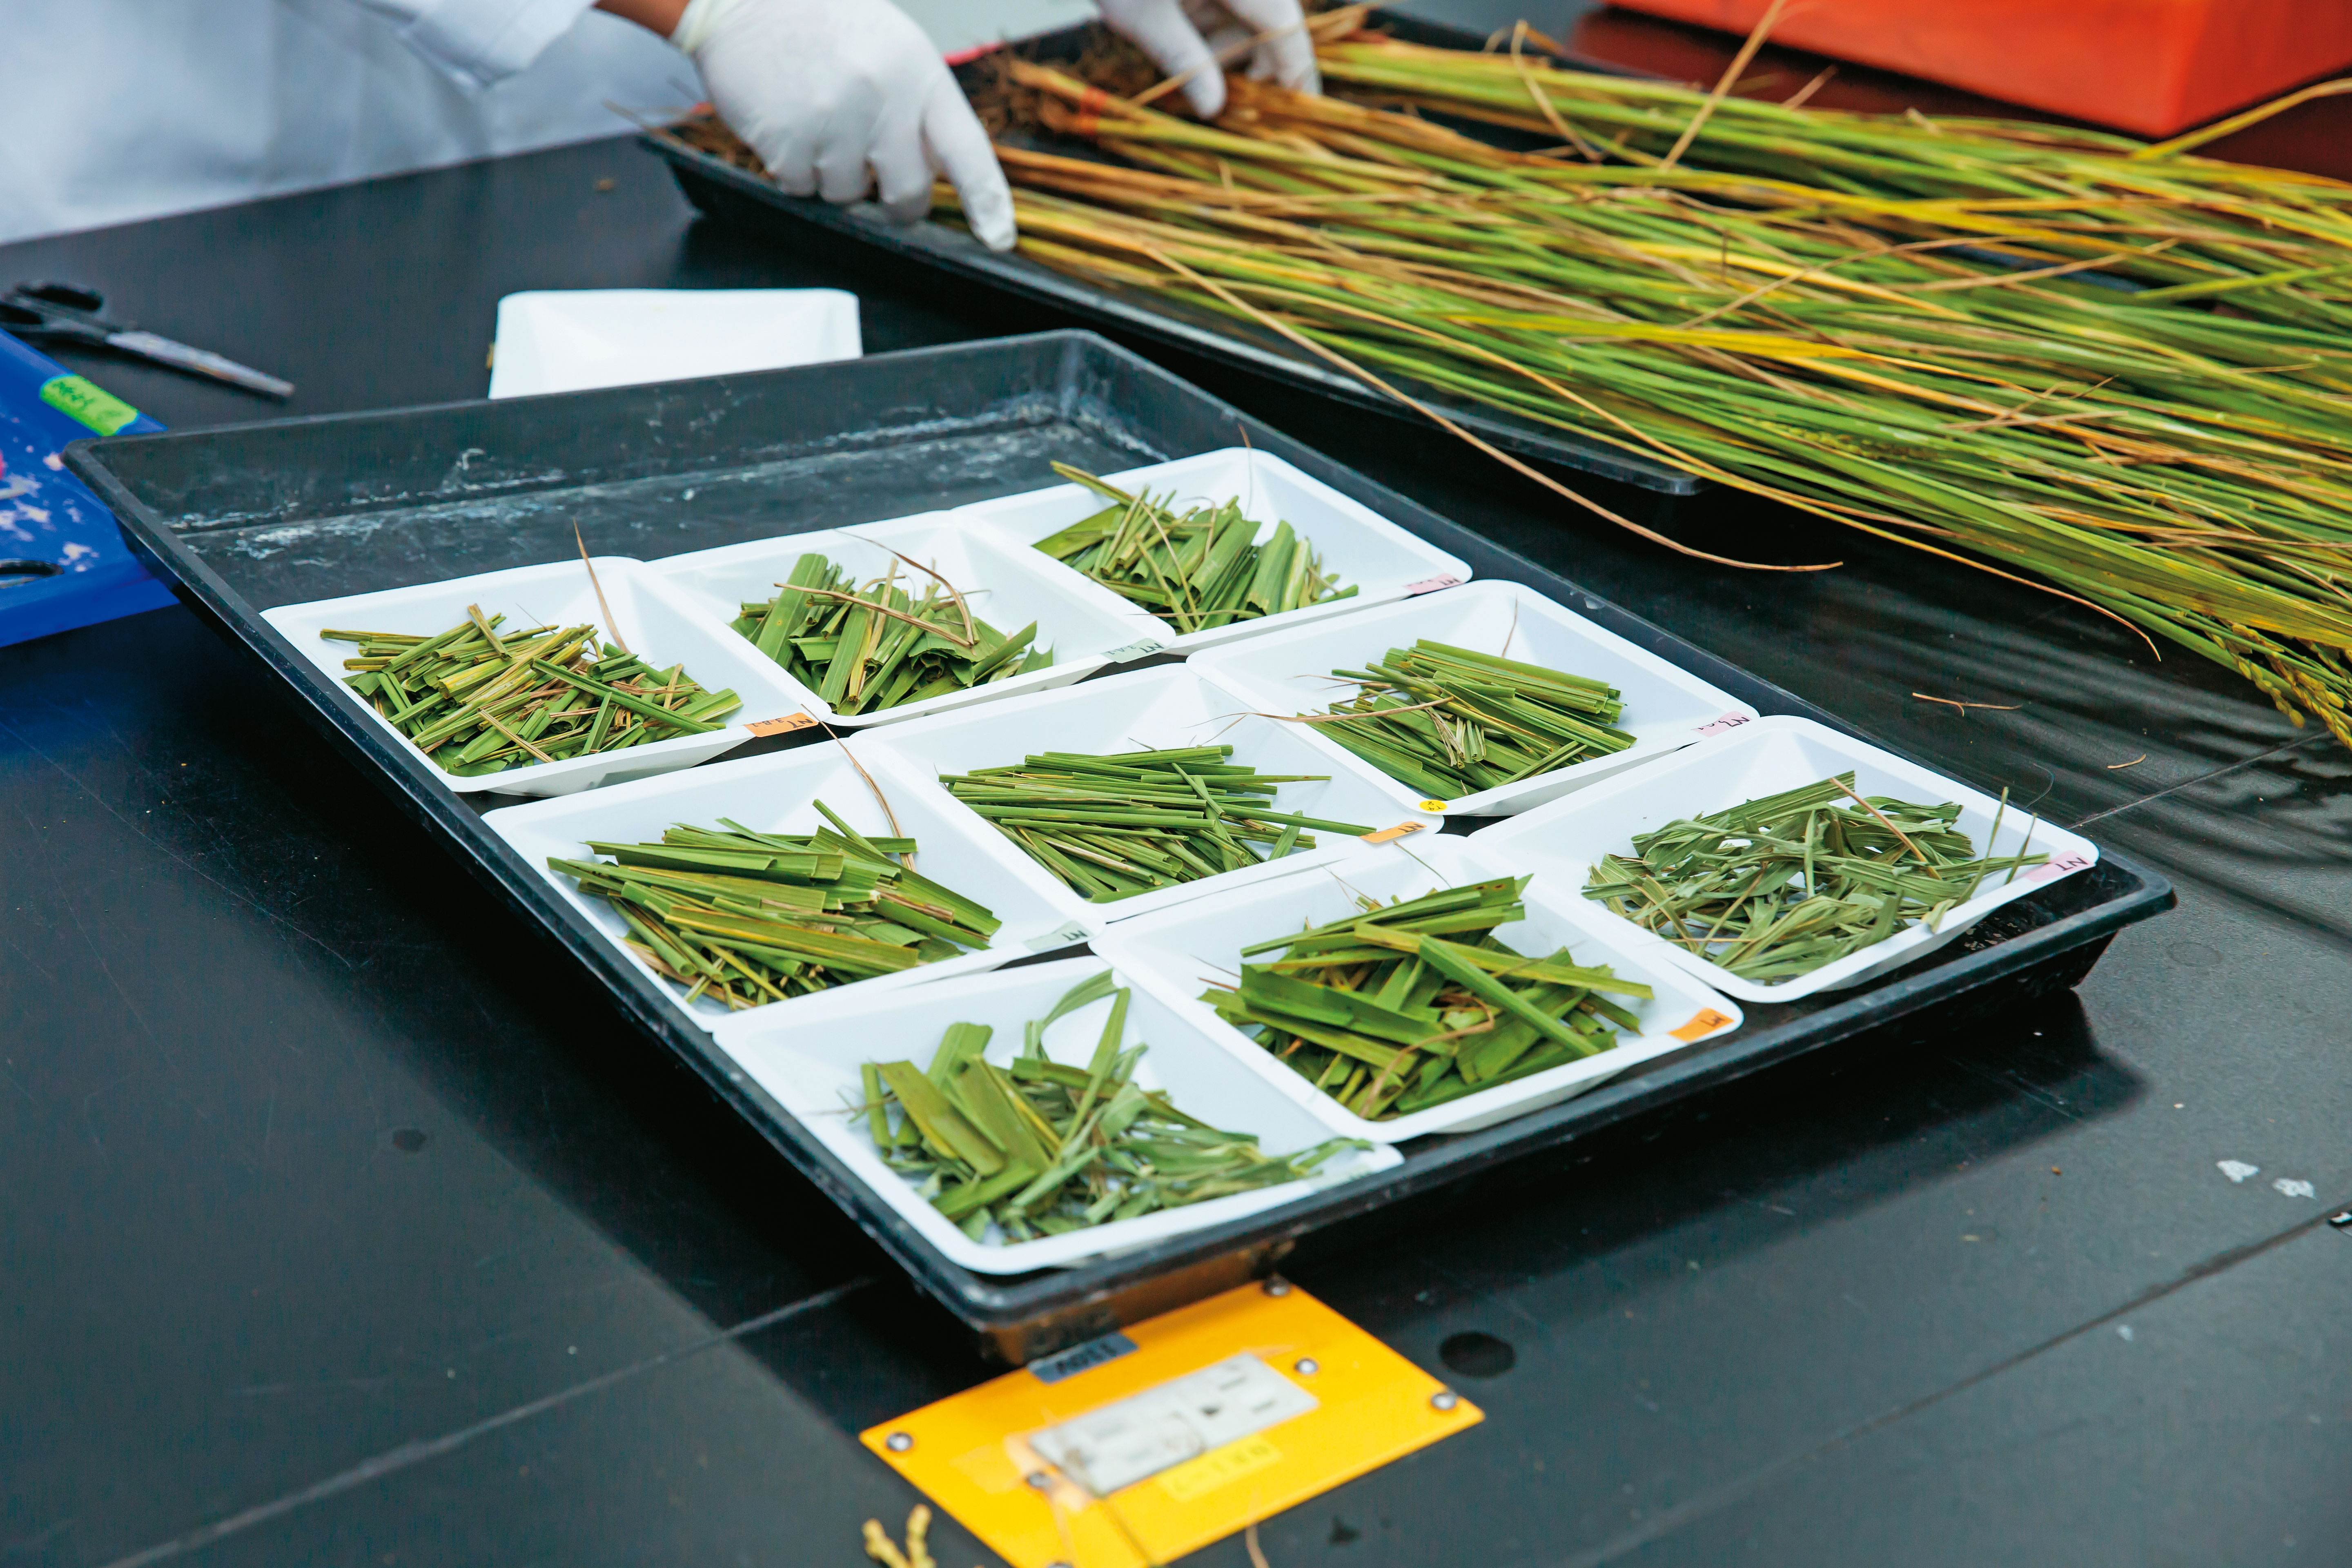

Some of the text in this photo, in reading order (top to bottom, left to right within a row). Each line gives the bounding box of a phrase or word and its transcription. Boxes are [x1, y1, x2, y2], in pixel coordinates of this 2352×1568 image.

[1139, 643, 1165, 653] NT
[786, 719, 813, 728] NT
[1397, 823, 1425, 833] NT
[2055, 857, 2089, 871] NT
[1062, 930, 1088, 941] NT
